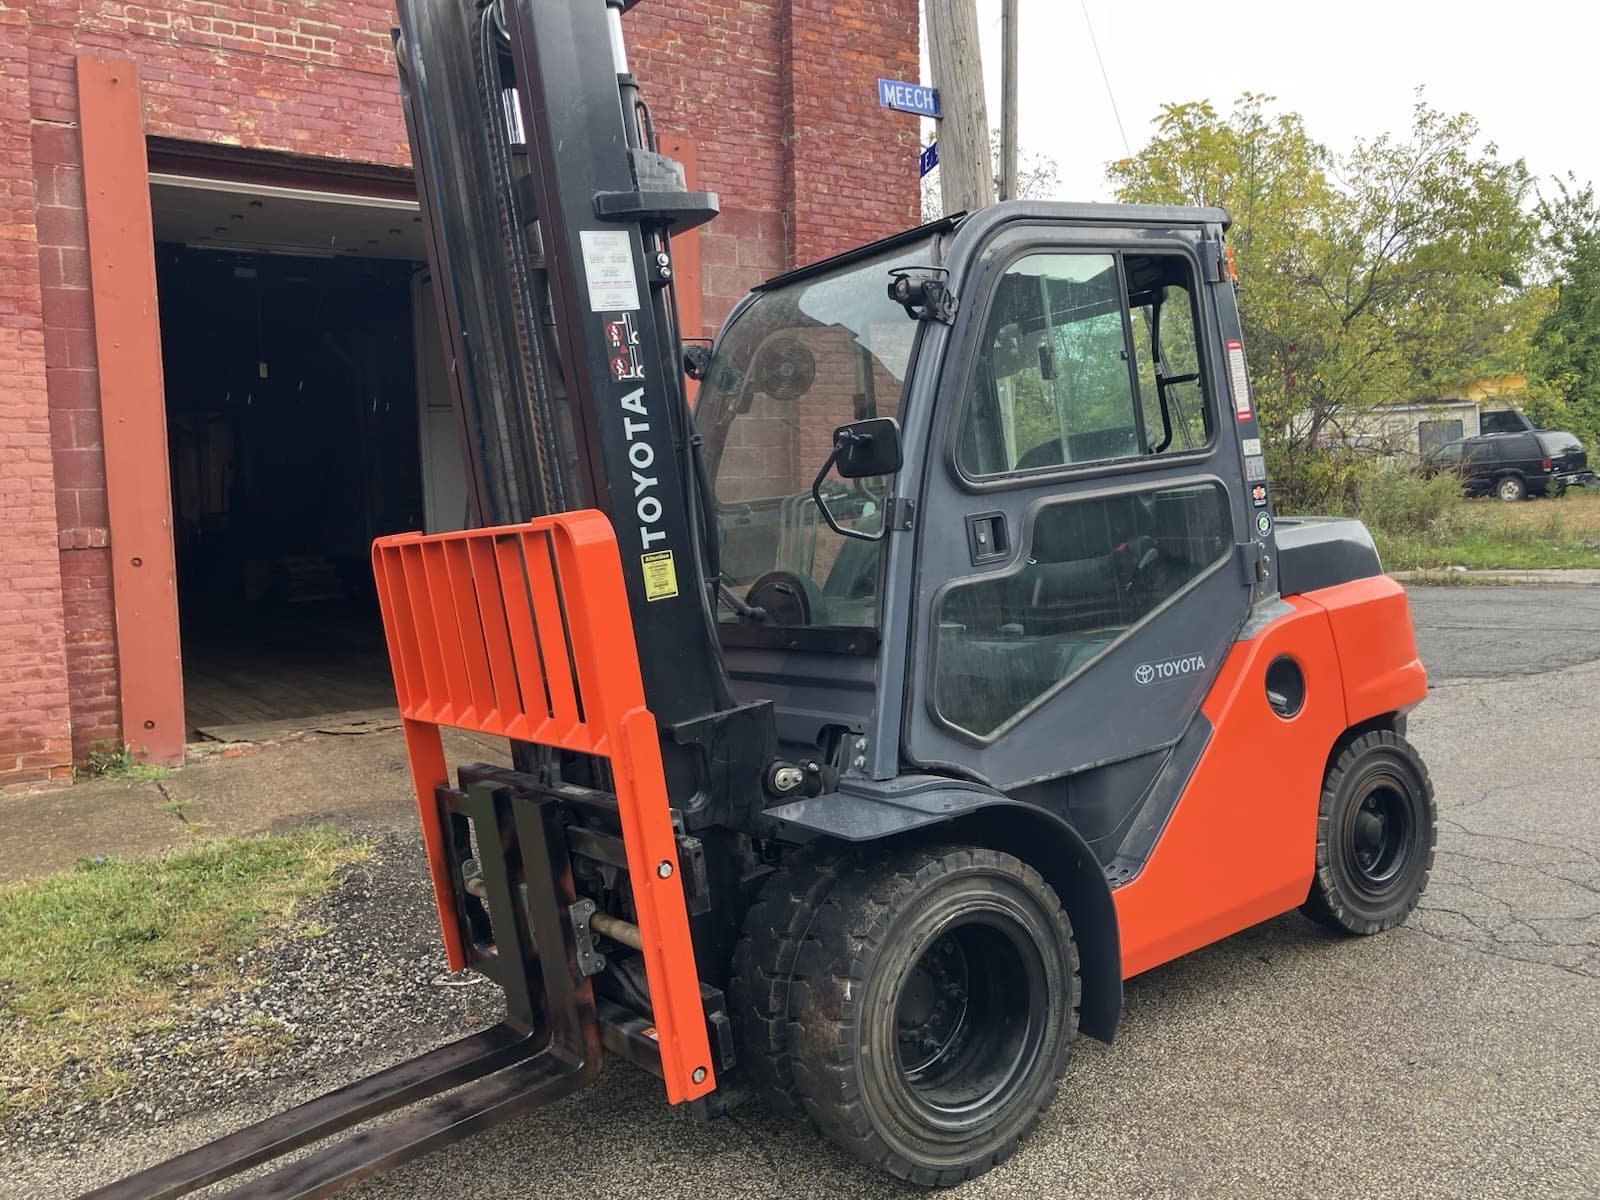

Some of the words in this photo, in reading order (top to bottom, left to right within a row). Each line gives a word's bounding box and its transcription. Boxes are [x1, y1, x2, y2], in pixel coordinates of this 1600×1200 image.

[884, 84, 933, 110] MEECH
[620, 386, 667, 550] TOYOTA
[1155, 656, 1206, 678] TOYOTA
